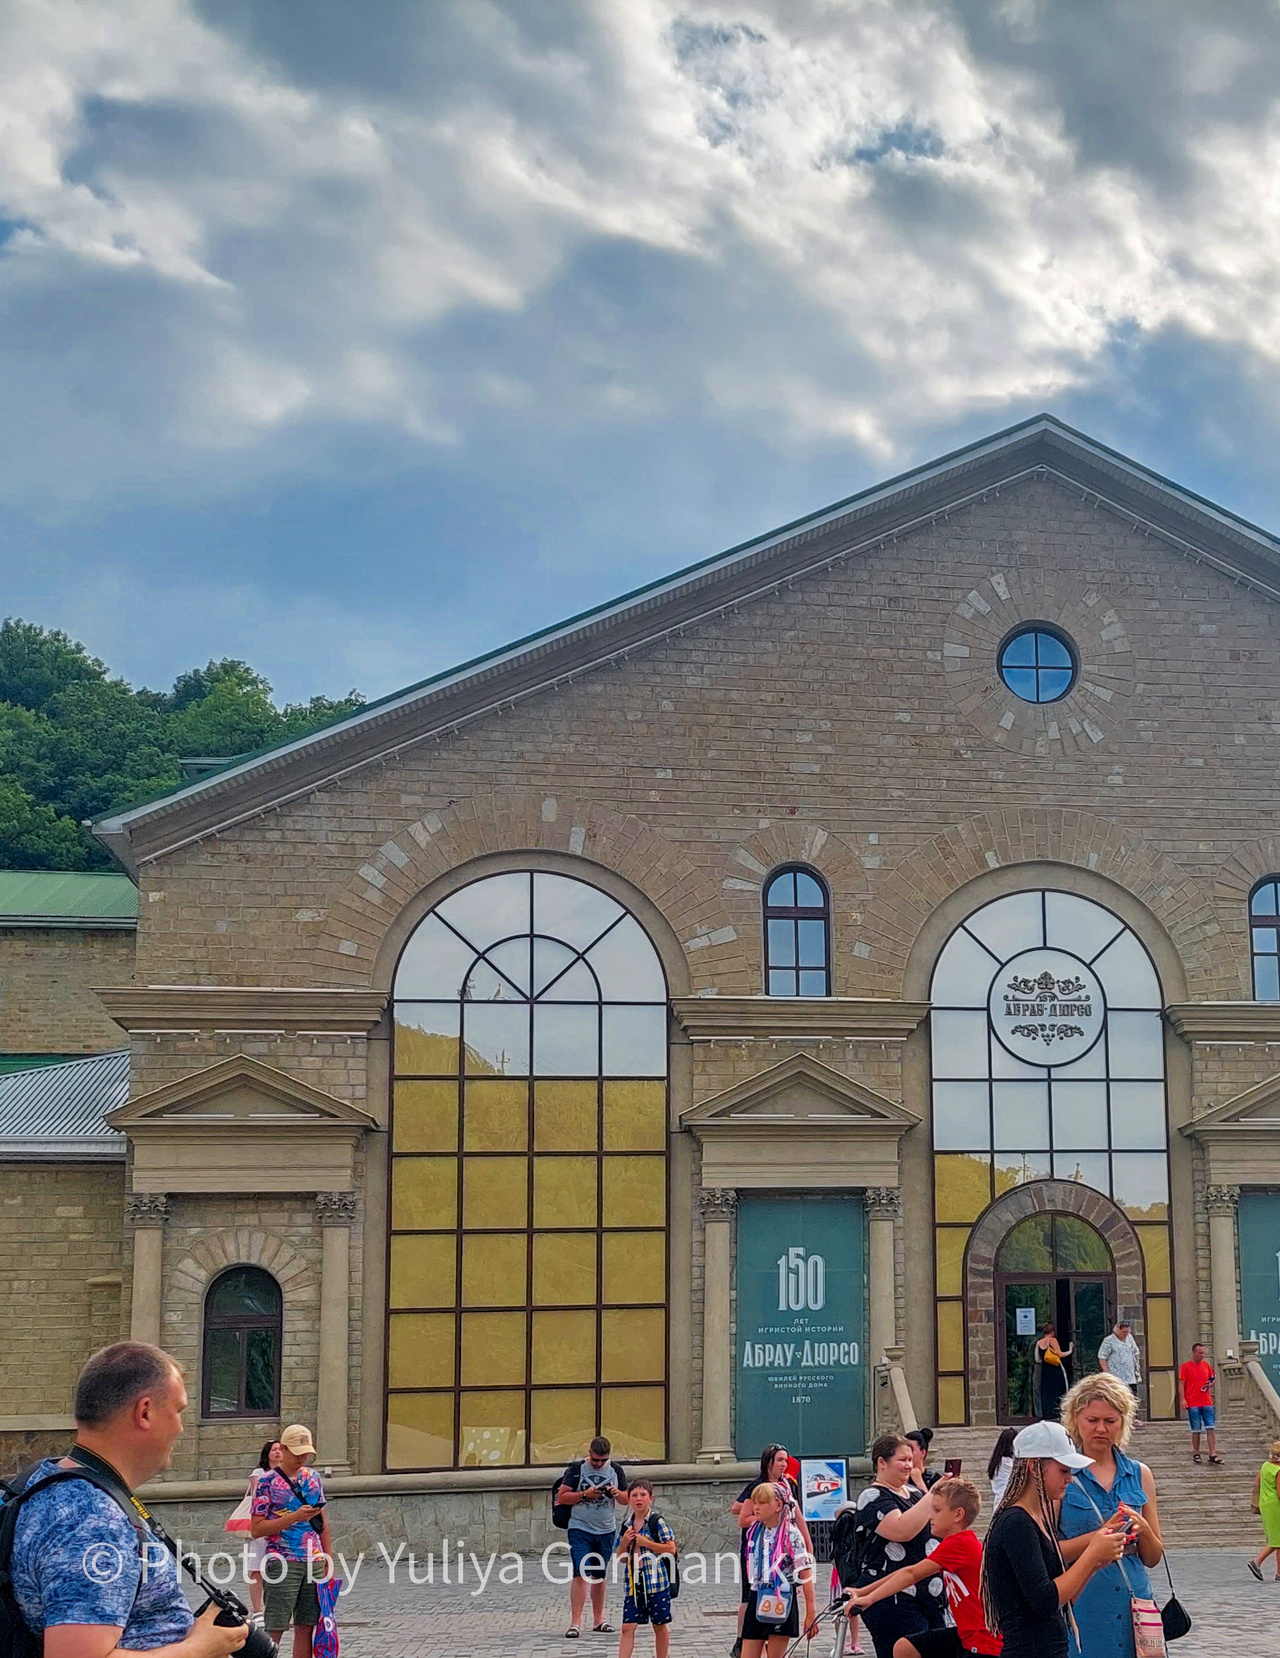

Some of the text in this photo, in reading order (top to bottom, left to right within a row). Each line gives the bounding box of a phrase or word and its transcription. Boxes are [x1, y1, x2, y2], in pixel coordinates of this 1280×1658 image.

[776, 1246, 825, 1312] 150
[758, 1325, 845, 1334] ИГРИСТОЙ ИСТОРИИ
[791, 1396, 811, 1404] 1870
